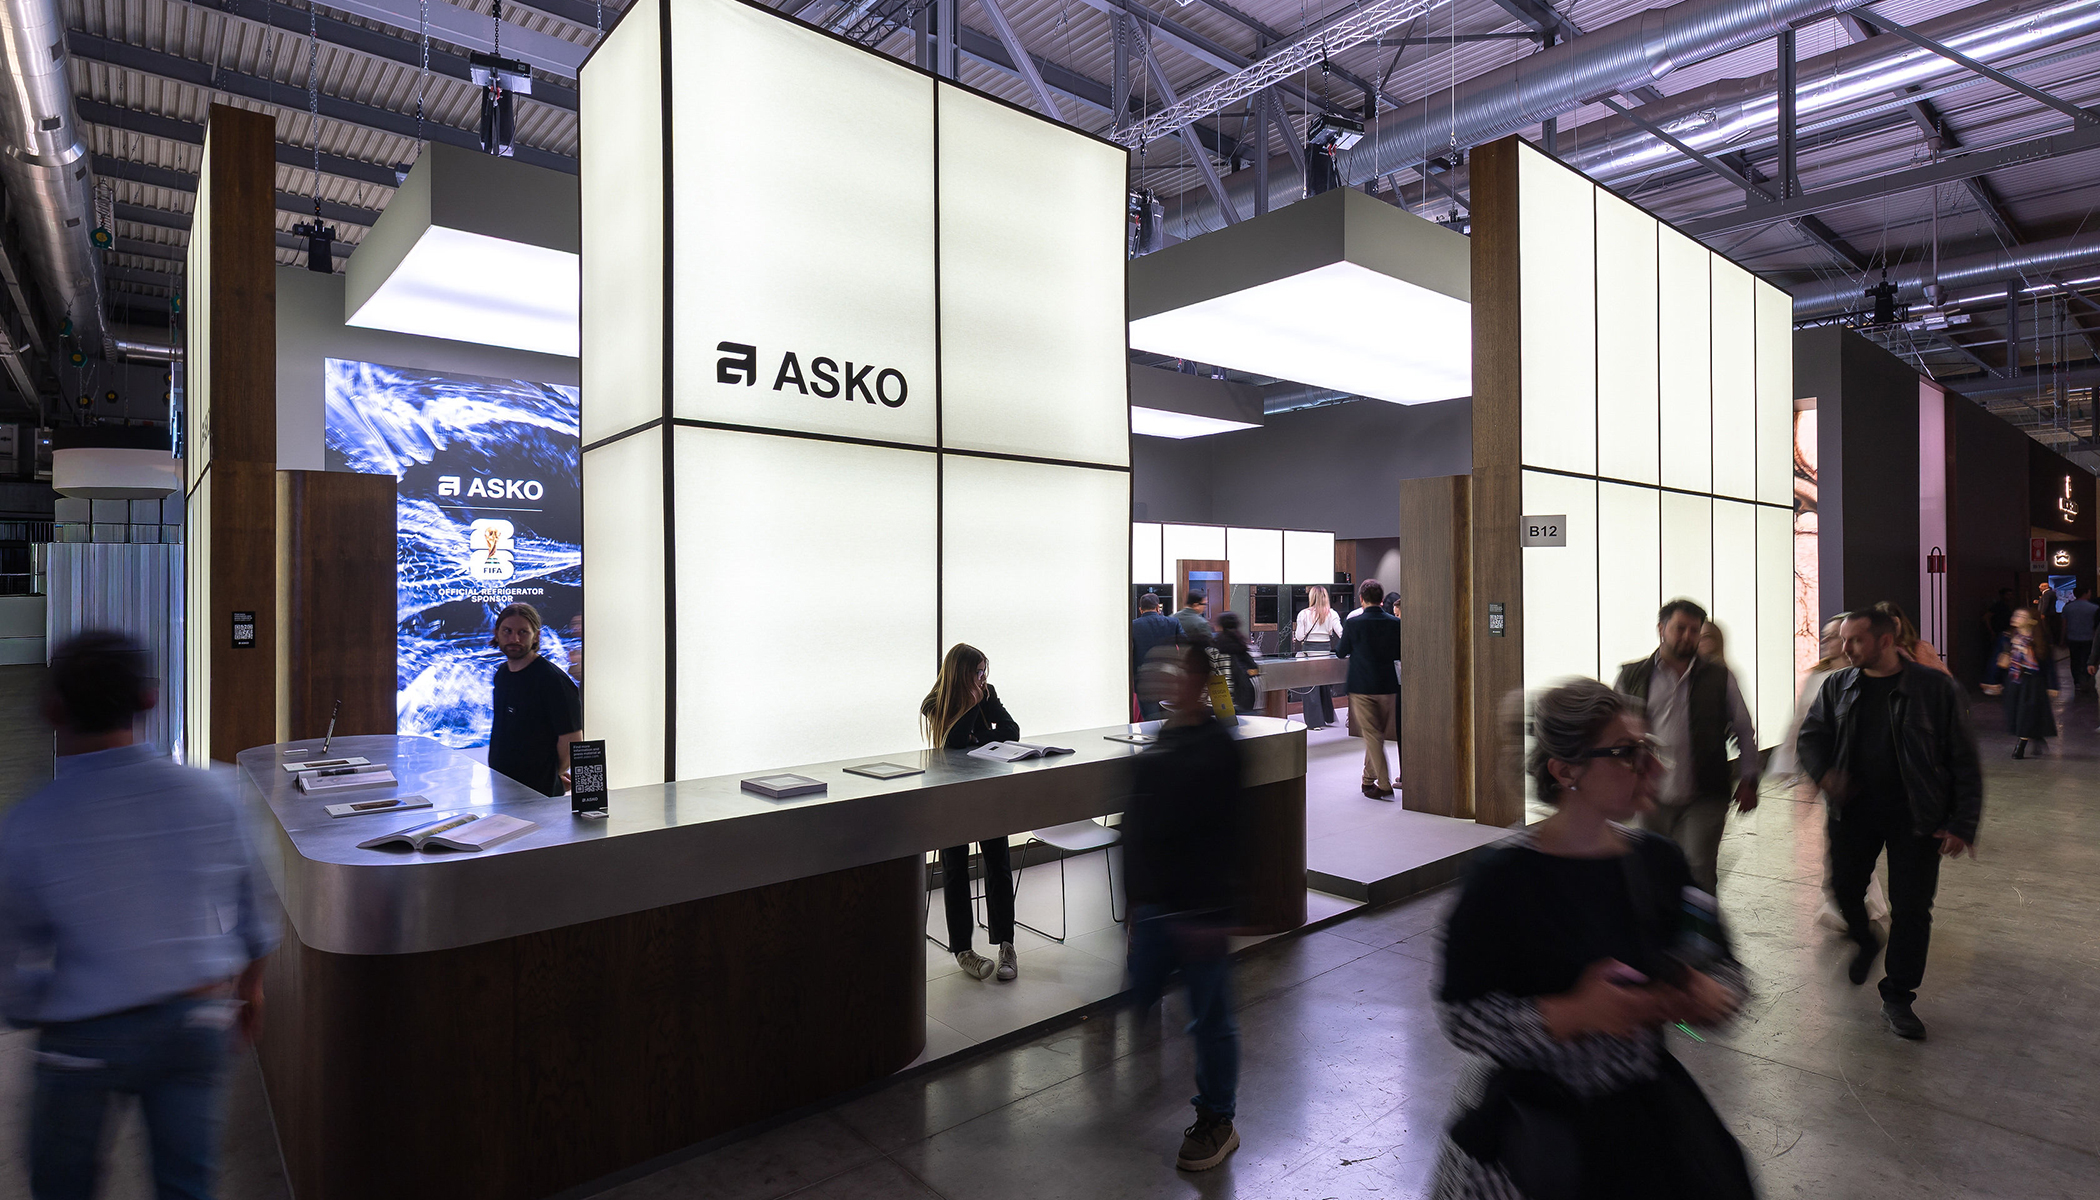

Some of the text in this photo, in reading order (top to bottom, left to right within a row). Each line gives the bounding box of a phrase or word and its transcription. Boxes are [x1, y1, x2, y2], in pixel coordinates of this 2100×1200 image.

[772, 351, 908, 408] ASKO
[467, 477, 544, 500] ASKO
[1530, 525, 1557, 537] B12
[438, 588, 477, 596] OFFICIAL
[471, 595, 513, 603] SPONSOR
